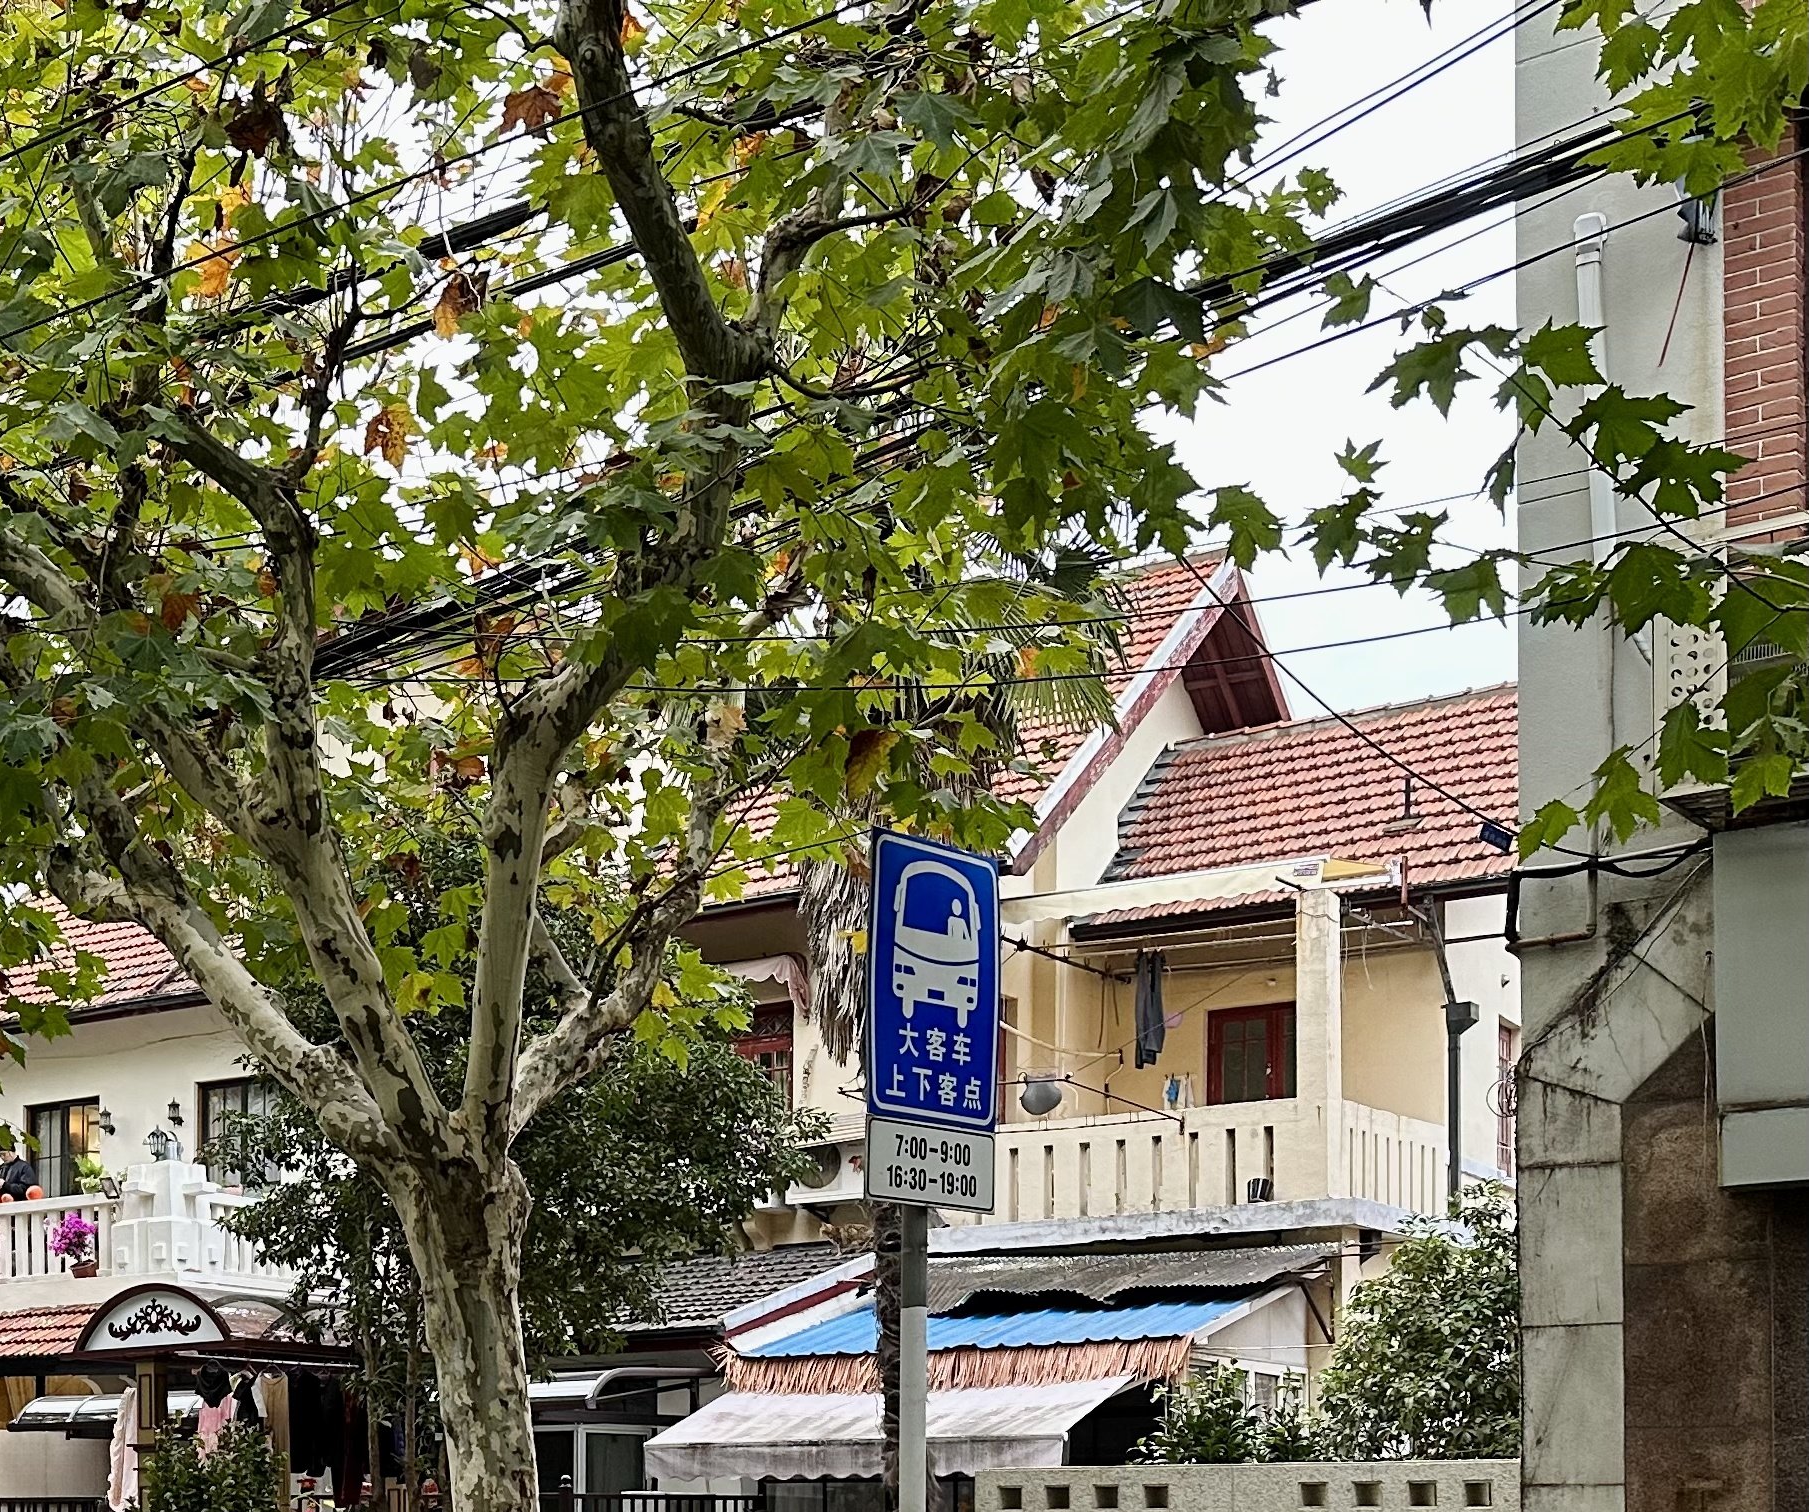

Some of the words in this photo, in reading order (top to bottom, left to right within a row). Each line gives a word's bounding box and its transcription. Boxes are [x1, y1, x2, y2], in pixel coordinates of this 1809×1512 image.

[898, 1022, 971, 1066] 大客车
[885, 1063, 981, 1110] 上下客点
[895, 1133, 971, 1167] 7:00-9:00
[886, 1165, 977, 1198] 16:30-19:00
